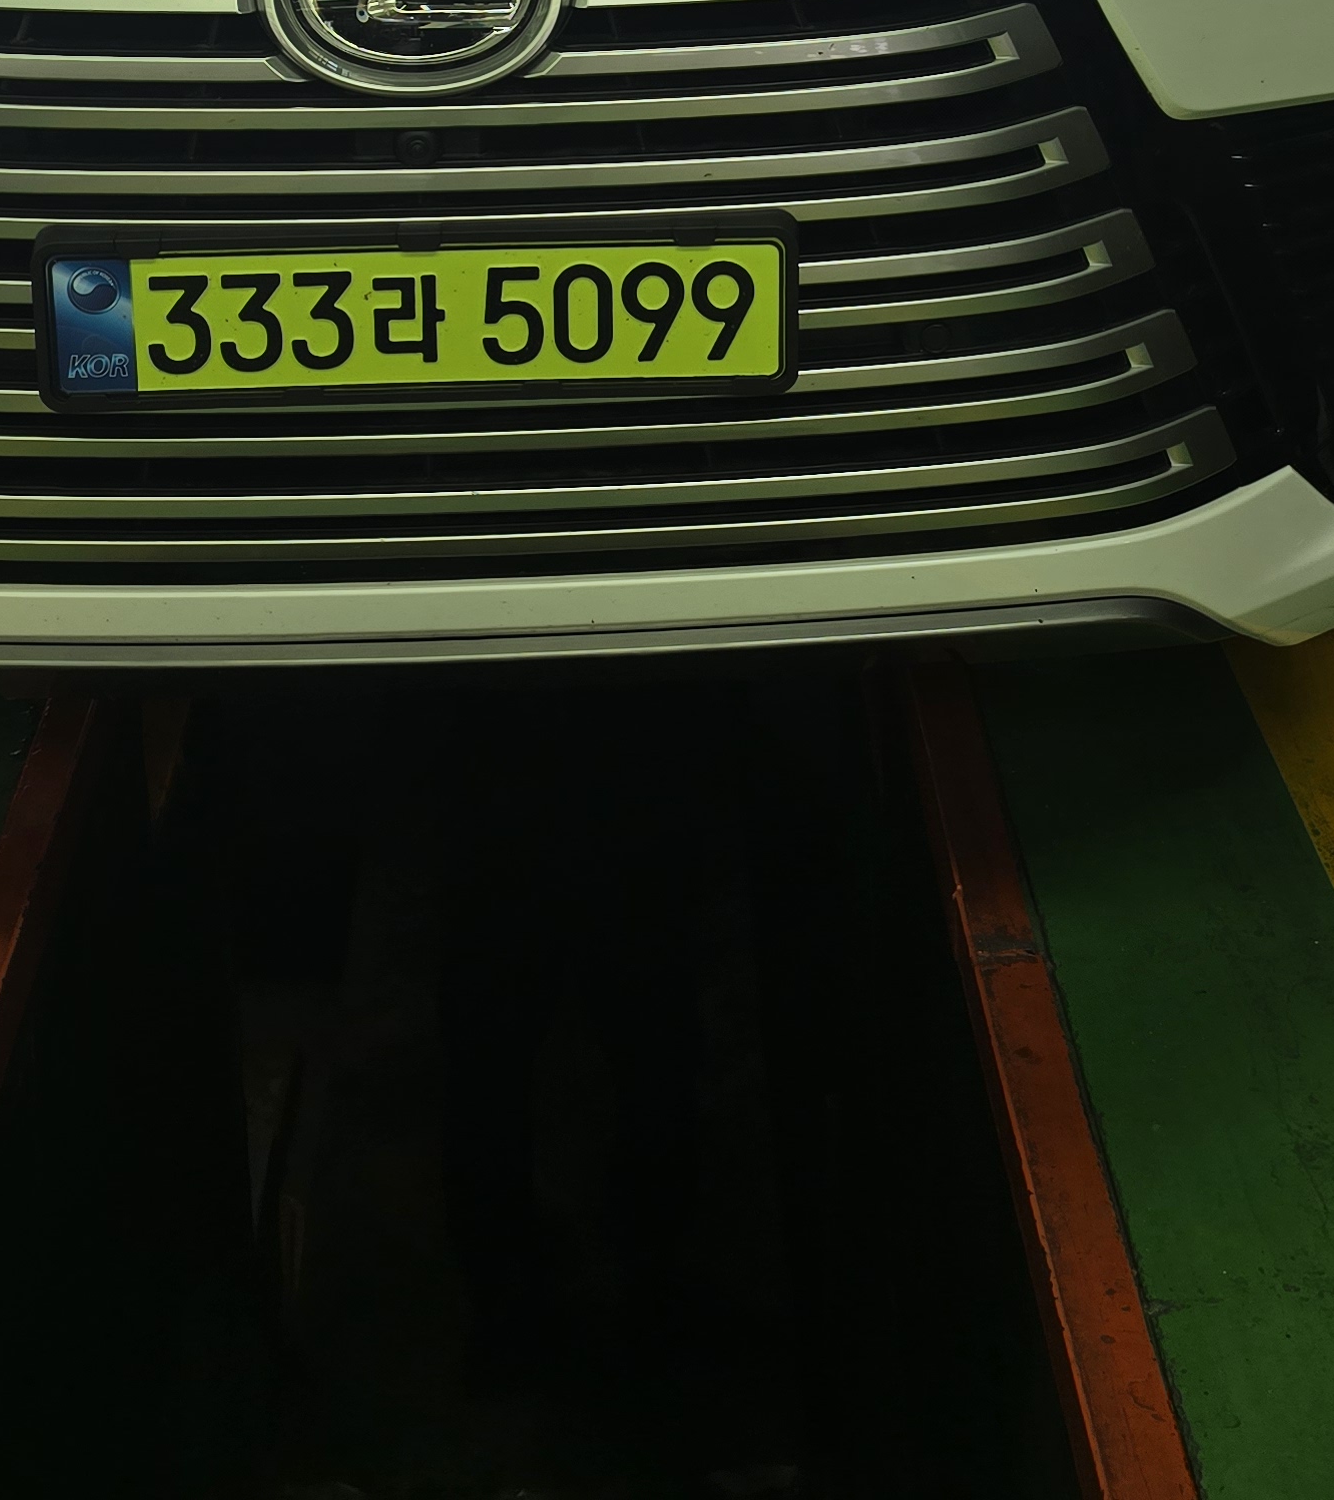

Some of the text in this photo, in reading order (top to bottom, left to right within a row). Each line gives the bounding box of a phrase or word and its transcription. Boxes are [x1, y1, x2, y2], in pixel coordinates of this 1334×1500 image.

[148, 261, 755, 376] 333라 5099
[68, 353, 129, 378] KOR
